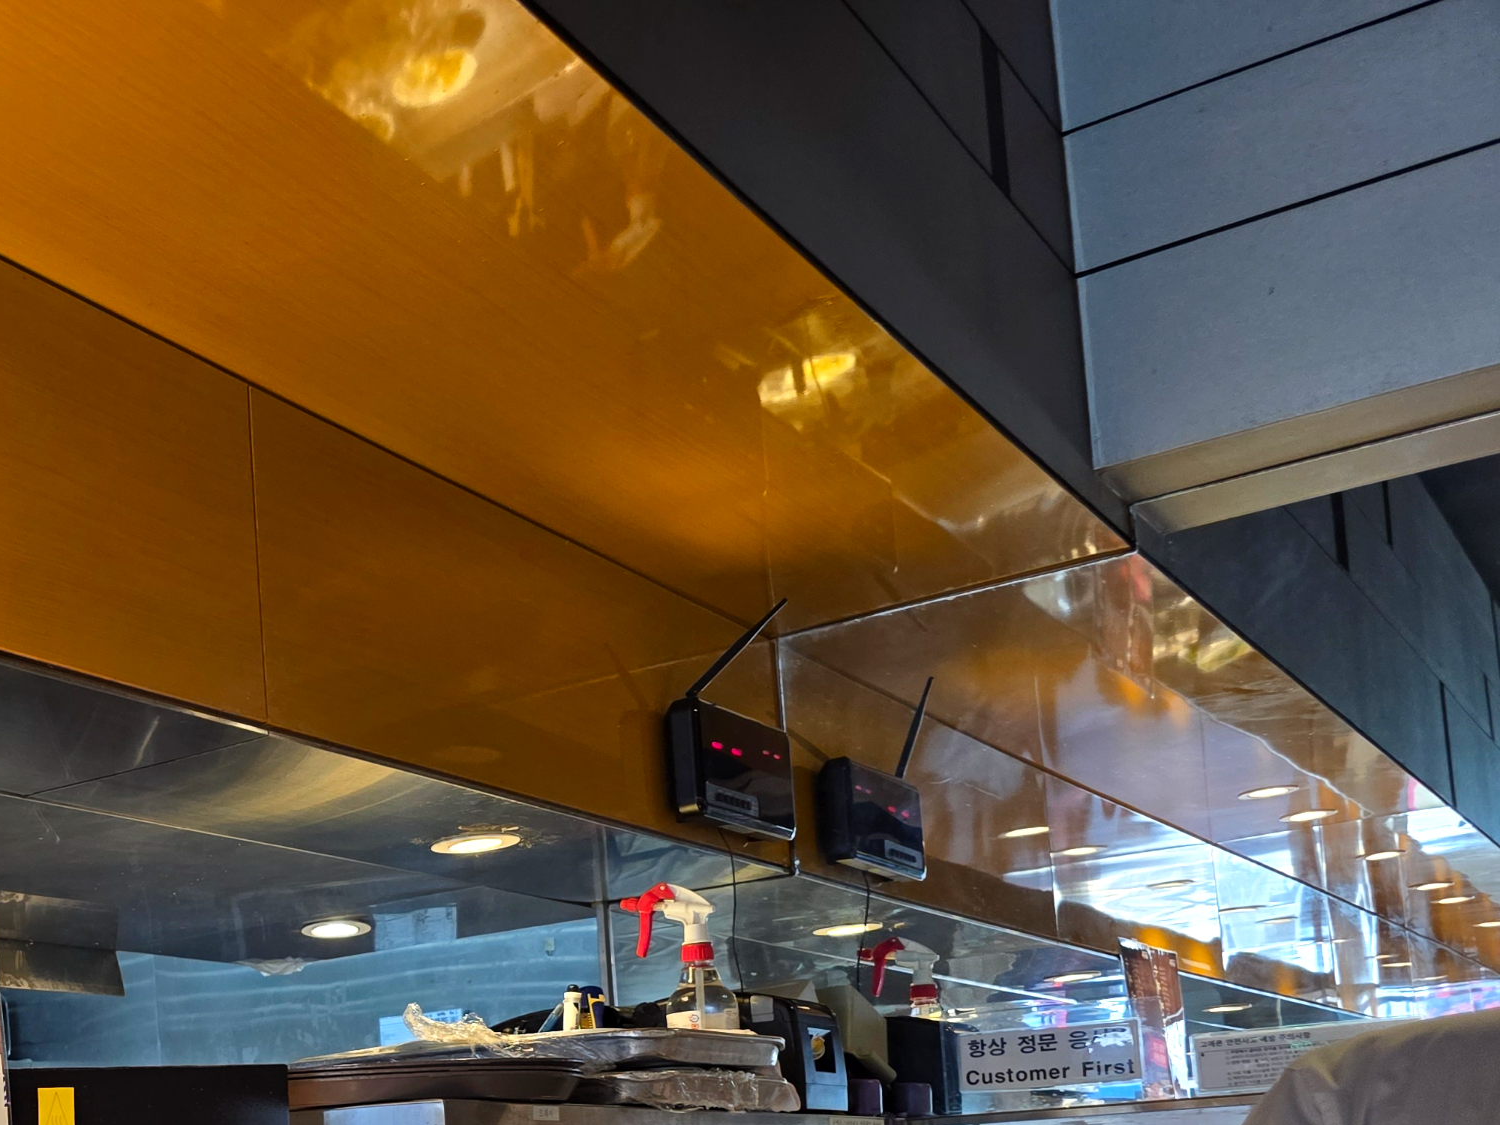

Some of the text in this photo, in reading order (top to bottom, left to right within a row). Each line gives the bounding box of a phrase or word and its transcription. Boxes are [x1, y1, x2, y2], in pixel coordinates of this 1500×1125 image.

[967, 1036, 1007, 1058] 항상
[1017, 1033, 1058, 1054] 정문
[966, 1059, 1135, 1086] Customer First
